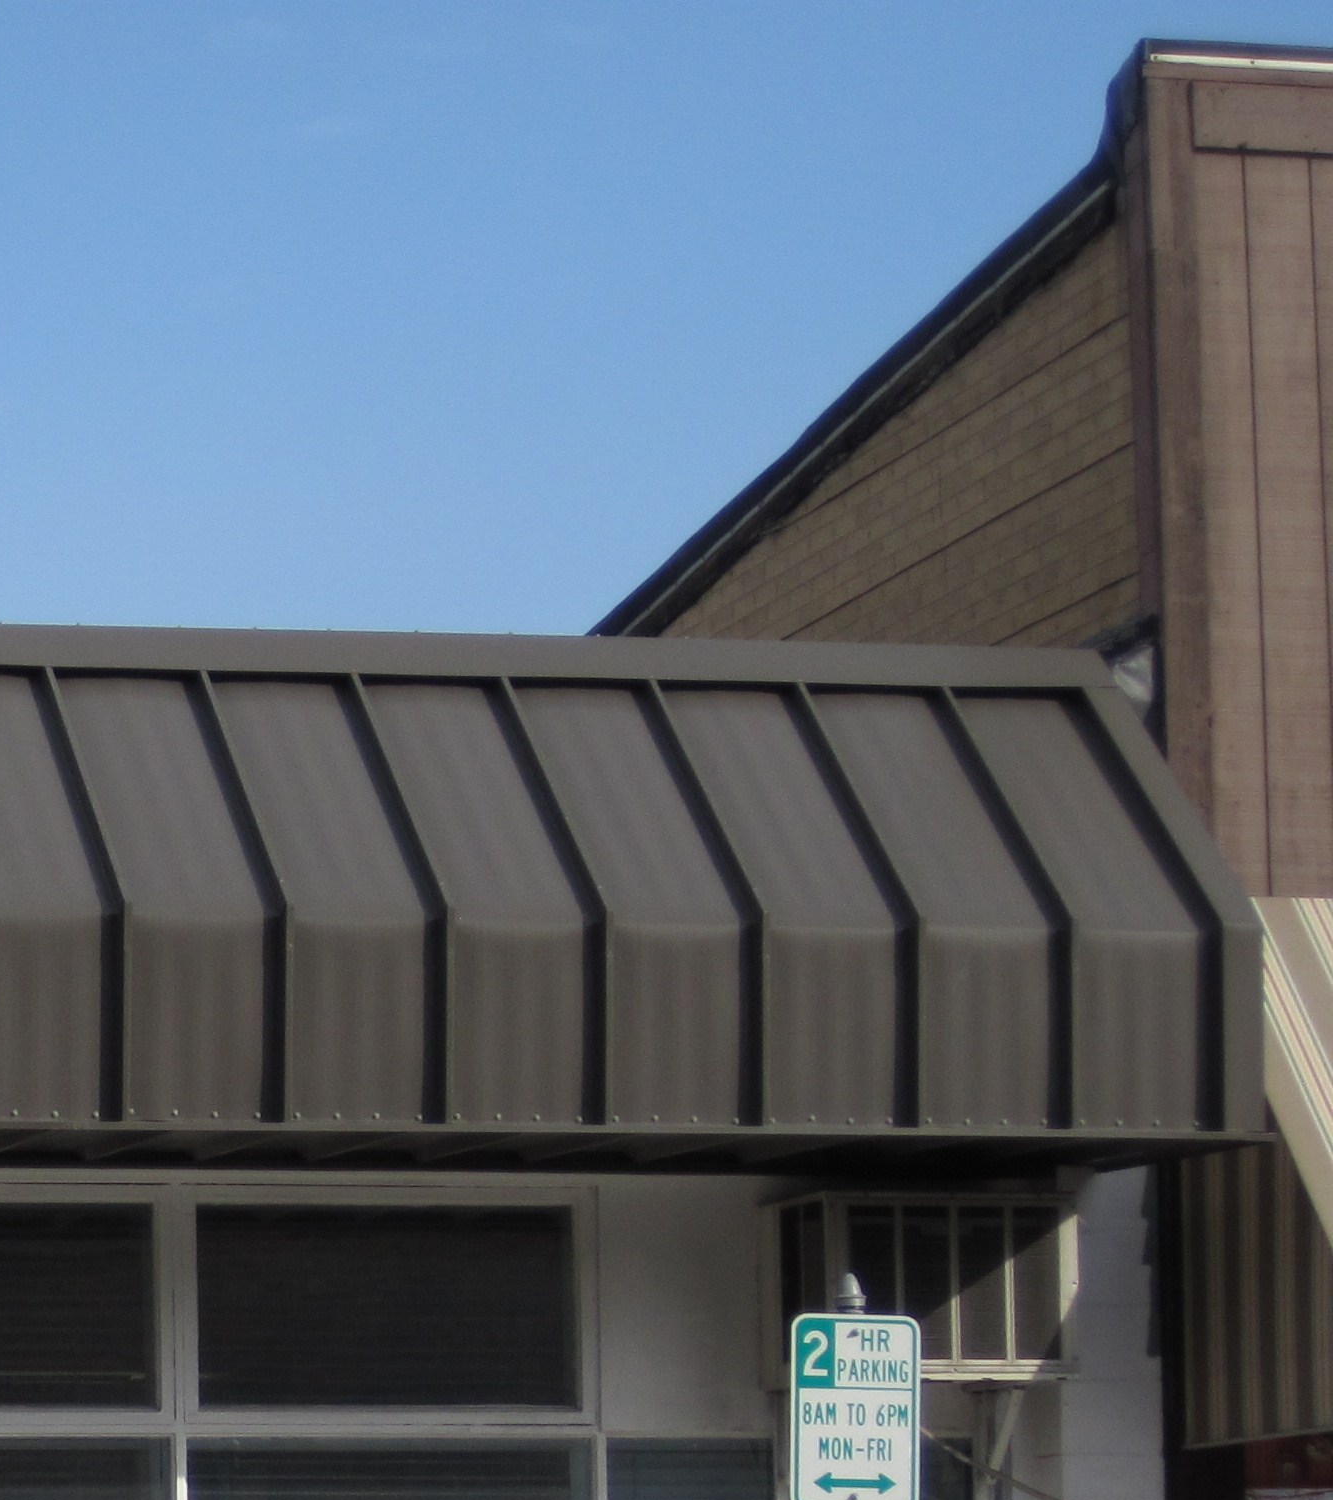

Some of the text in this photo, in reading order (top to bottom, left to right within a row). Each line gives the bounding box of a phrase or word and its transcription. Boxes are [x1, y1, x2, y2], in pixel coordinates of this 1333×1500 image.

[802, 1329, 891, 1377] 2 HR
[837, 1358, 910, 1383] PARKING
[802, 1402, 909, 1428] 8AM TO 6PM
[818, 1437, 892, 1462] MON-FRI
